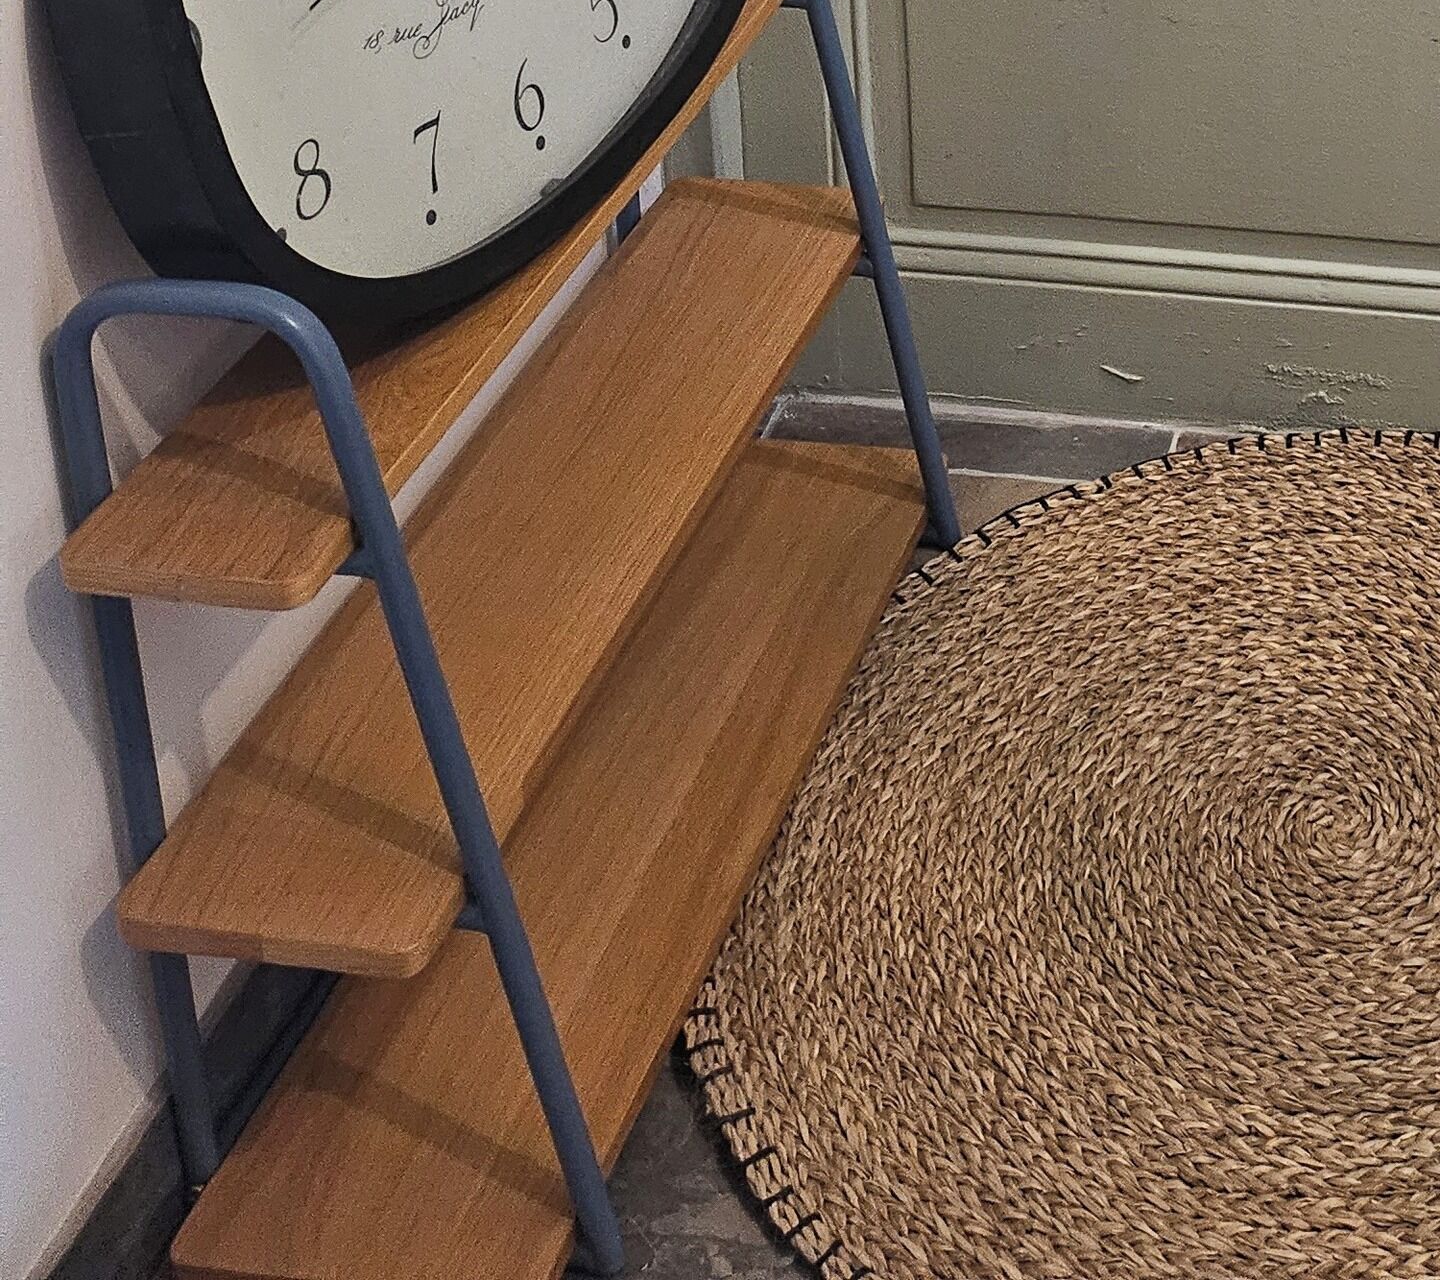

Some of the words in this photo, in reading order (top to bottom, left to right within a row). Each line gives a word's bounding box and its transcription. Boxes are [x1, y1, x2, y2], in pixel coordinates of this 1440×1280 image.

[387, 22, 424, 46] rue
[513, 56, 546, 132] 6
[293, 138, 332, 221] 8
[412, 108, 442, 195] 7
